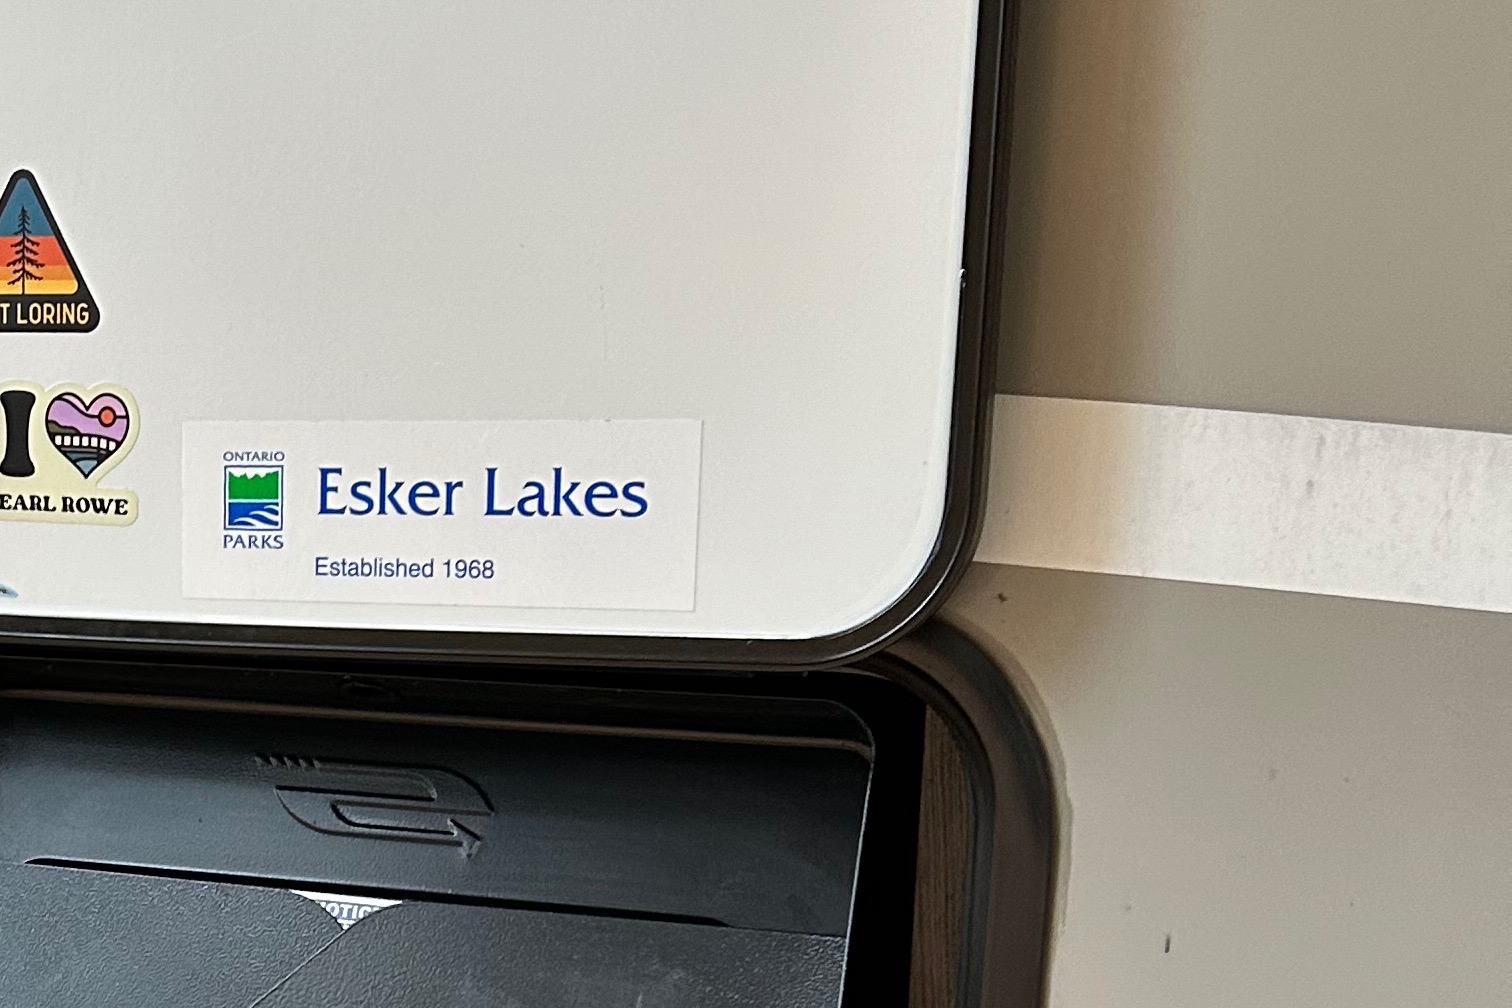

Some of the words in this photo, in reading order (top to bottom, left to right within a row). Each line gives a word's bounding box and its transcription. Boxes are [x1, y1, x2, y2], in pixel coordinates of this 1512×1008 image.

[17, 302, 89, 324] LORING
[0, 390, 36, 477] I
[222, 450, 285, 463] ONTARIO
[317, 466, 464, 517] Esker
[484, 467, 650, 518] Lakes
[61, 496, 129, 516] ROWE
[222, 535, 284, 549] PARKS
[314, 556, 434, 579] Established
[443, 558, 495, 579] 1968
